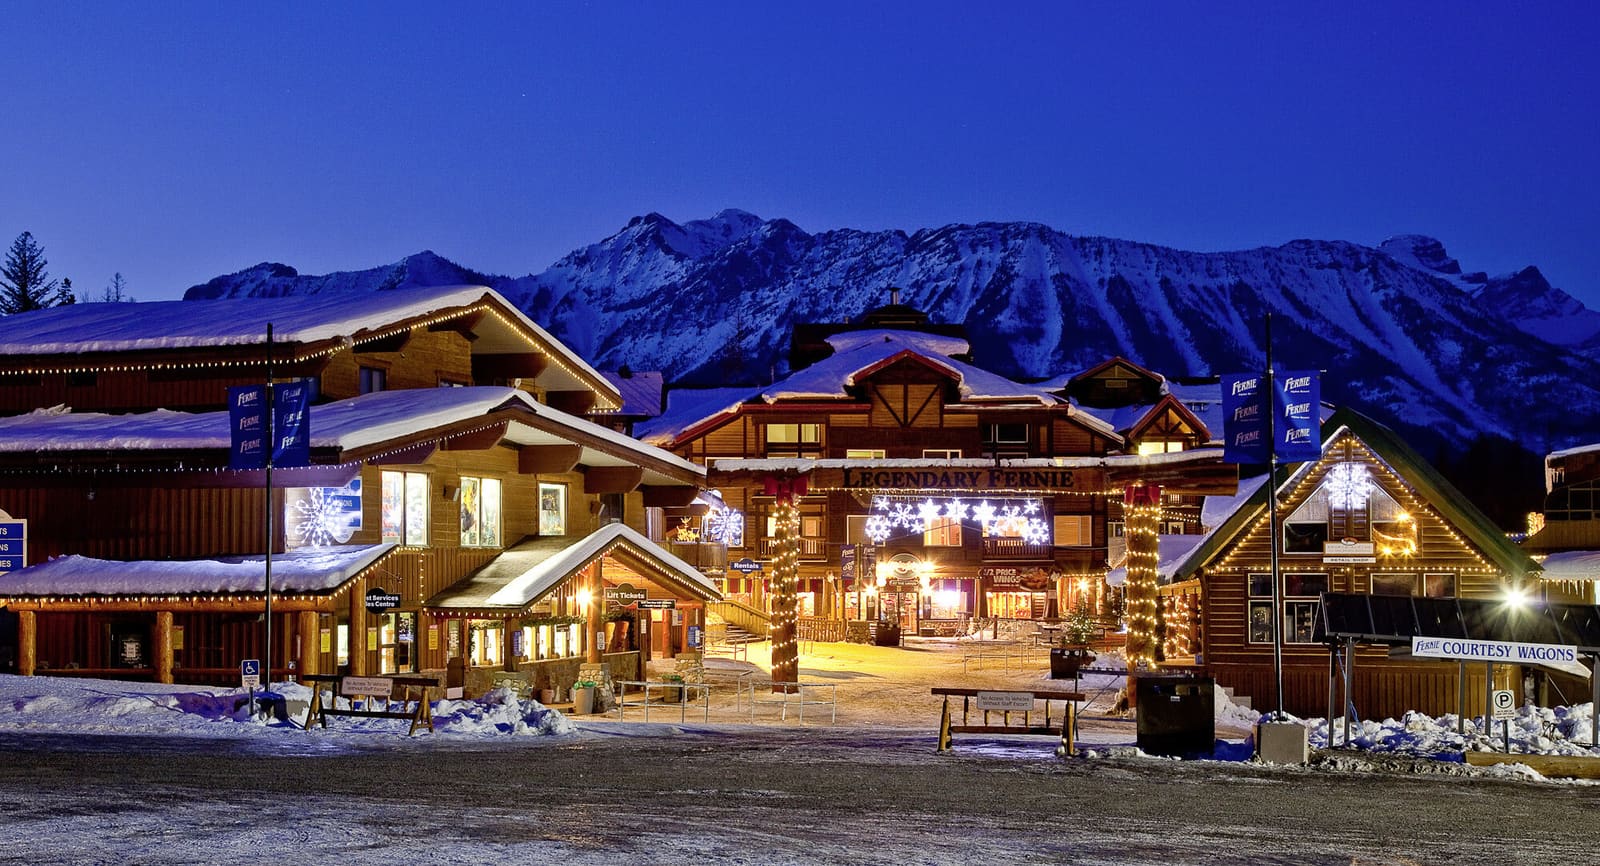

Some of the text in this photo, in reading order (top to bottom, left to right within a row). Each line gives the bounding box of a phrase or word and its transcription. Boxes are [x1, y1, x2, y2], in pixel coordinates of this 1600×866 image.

[1232, 379, 1257, 396] FERNIE
[1284, 377, 1310, 392] FERNIE
[238, 391, 258, 406] FERNIE
[1234, 405, 1258, 421] FERNIE
[1285, 403, 1310, 417] FERNIE
[240, 416, 260, 430] FERNIE
[1235, 431, 1260, 446] FERNIE
[1285, 428, 1310, 443] FERNIE
[240, 439, 261, 454] FERNIE
[842, 467, 1074, 488] LEGENDARY FERNIE
[1415, 640, 1574, 661] FERNIE COURTESY WAGONS
